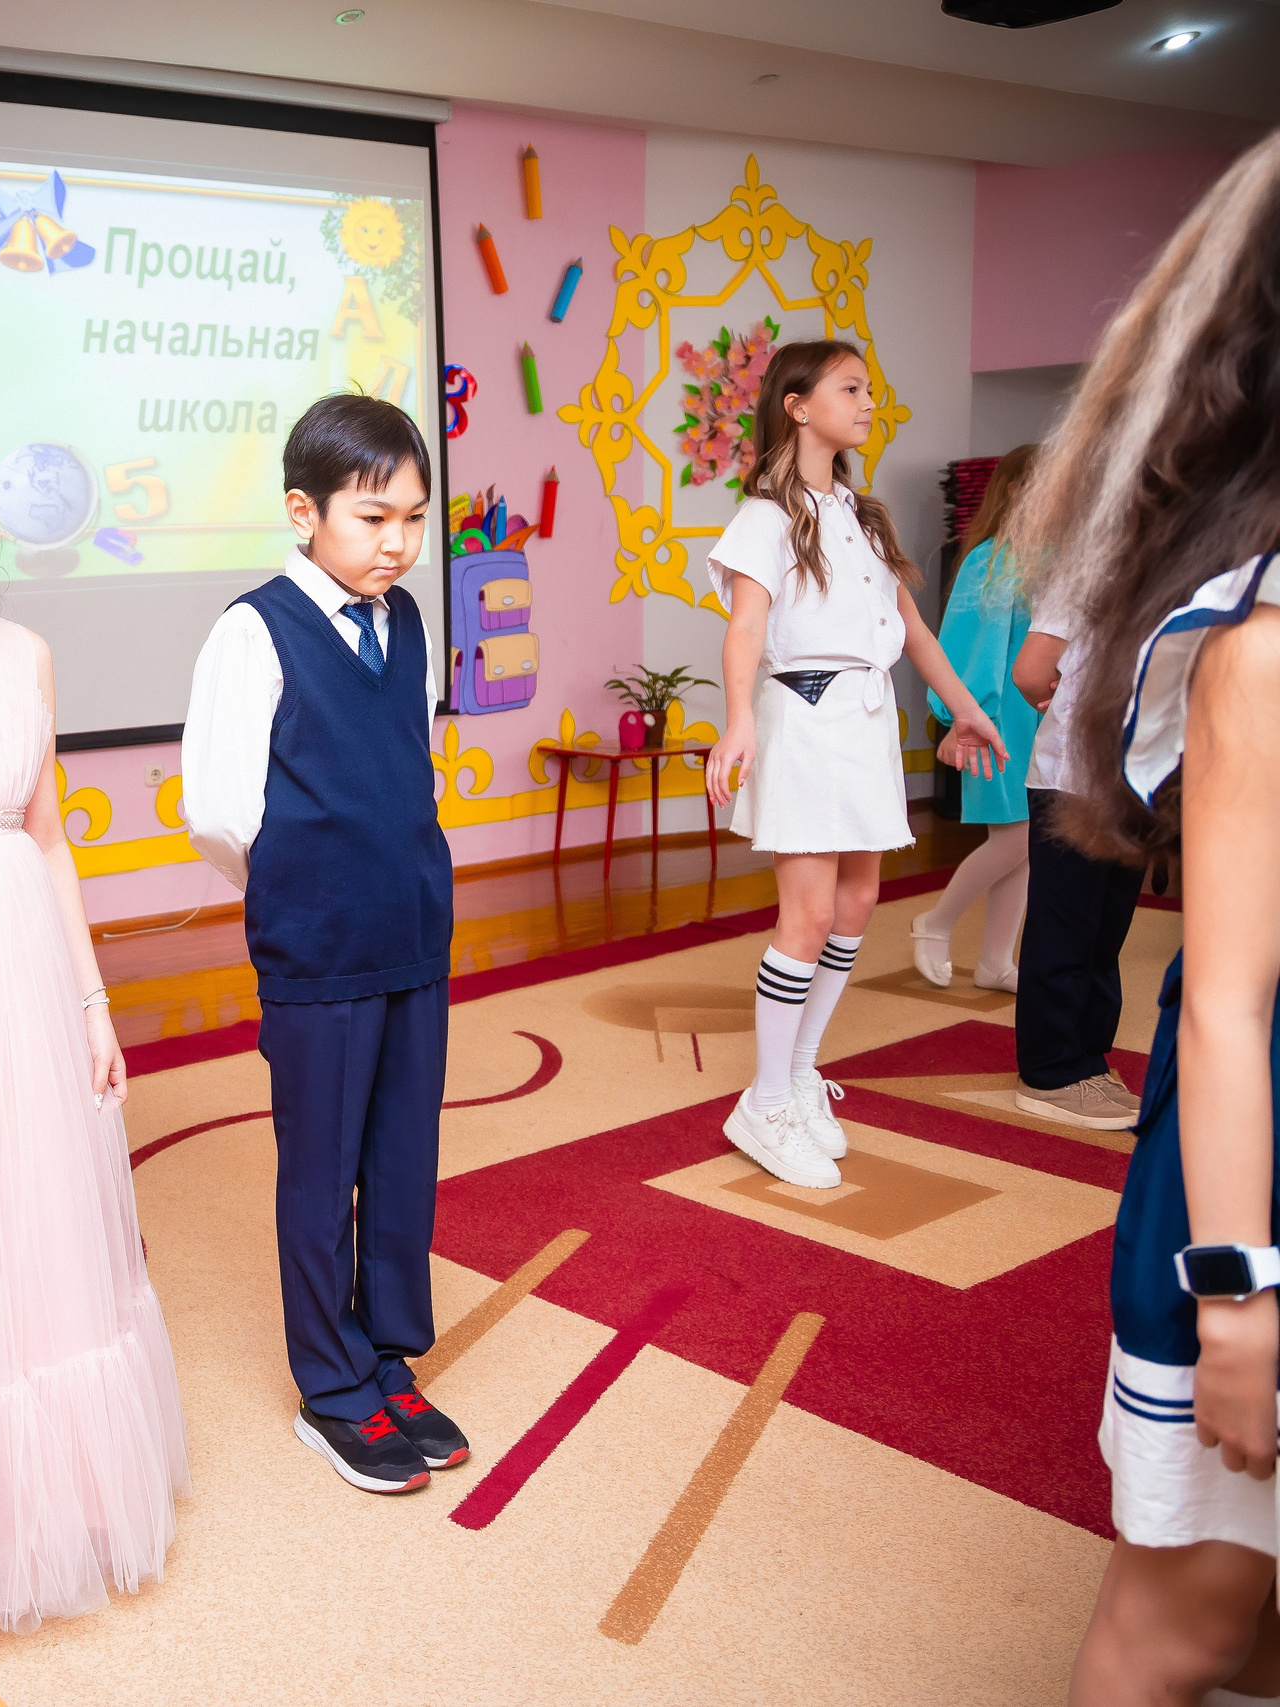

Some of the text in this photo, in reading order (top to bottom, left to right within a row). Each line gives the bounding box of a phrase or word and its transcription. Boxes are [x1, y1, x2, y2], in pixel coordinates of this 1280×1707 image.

[103, 226, 297, 292] Прощай,
[82, 318, 320, 362] начальная
[137, 397, 279, 434] школа
[104, 457, 170, 523] 5
